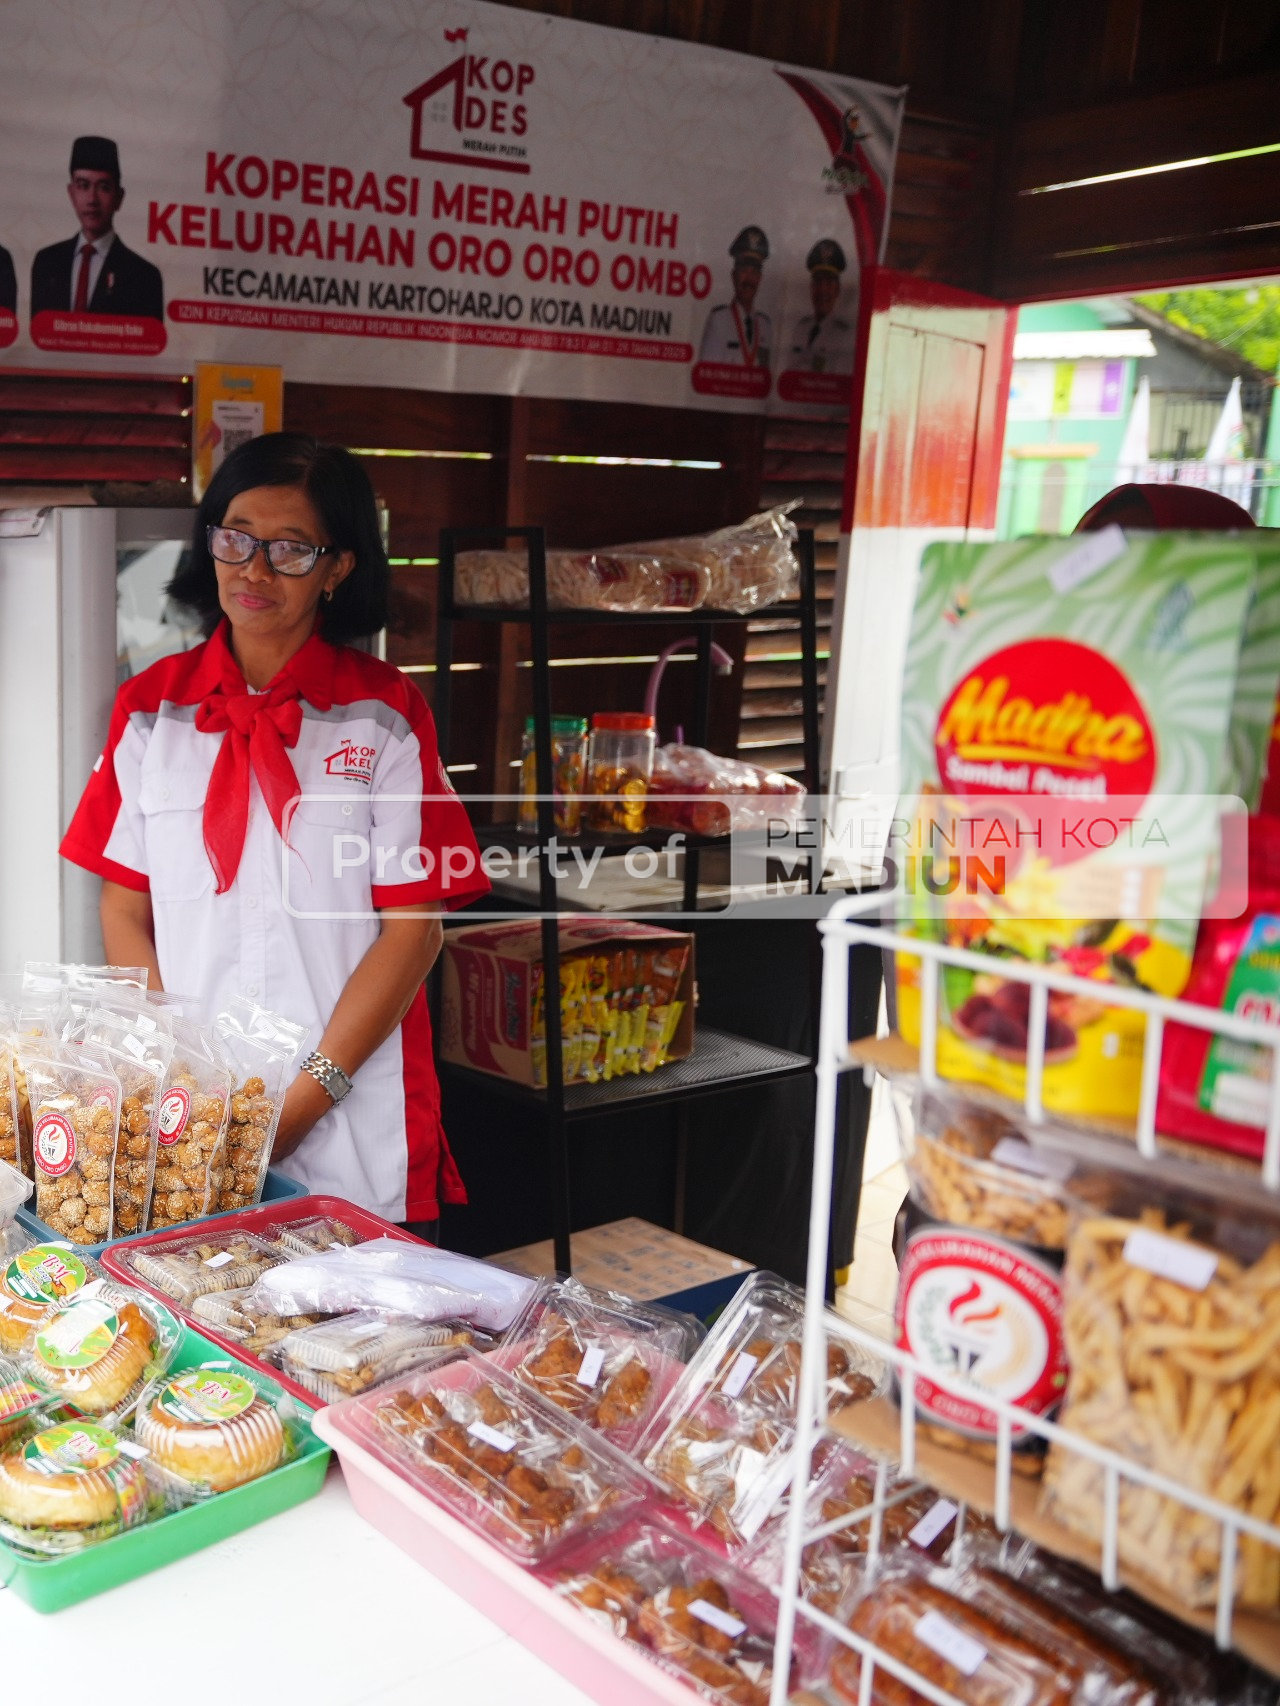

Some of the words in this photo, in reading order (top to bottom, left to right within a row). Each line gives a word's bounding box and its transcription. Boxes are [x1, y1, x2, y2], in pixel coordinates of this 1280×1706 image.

[467, 55, 535, 96] KOP
[464, 96, 528, 136] DES
[462, 138, 497, 153] MERAH
[498, 143, 528, 158] PUTIH
[205, 151, 419, 217] KOPERASI
[432, 180, 568, 235] MERAH
[577, 200, 679, 249] PUTIH
[147, 201, 415, 268] KELURAHAN
[429, 232, 512, 278] ORO
[523, 243, 600, 287] ORO
[610, 254, 712, 300] OMBO
[203, 266, 360, 307] KECAMATAN
[368, 281, 523, 321] KARTOHARJO
[530, 297, 584, 327] KOTA
[590, 304, 671, 336] MADIUN
[348, 757, 372, 770] KEL
[350, 746, 376, 758] KOP
